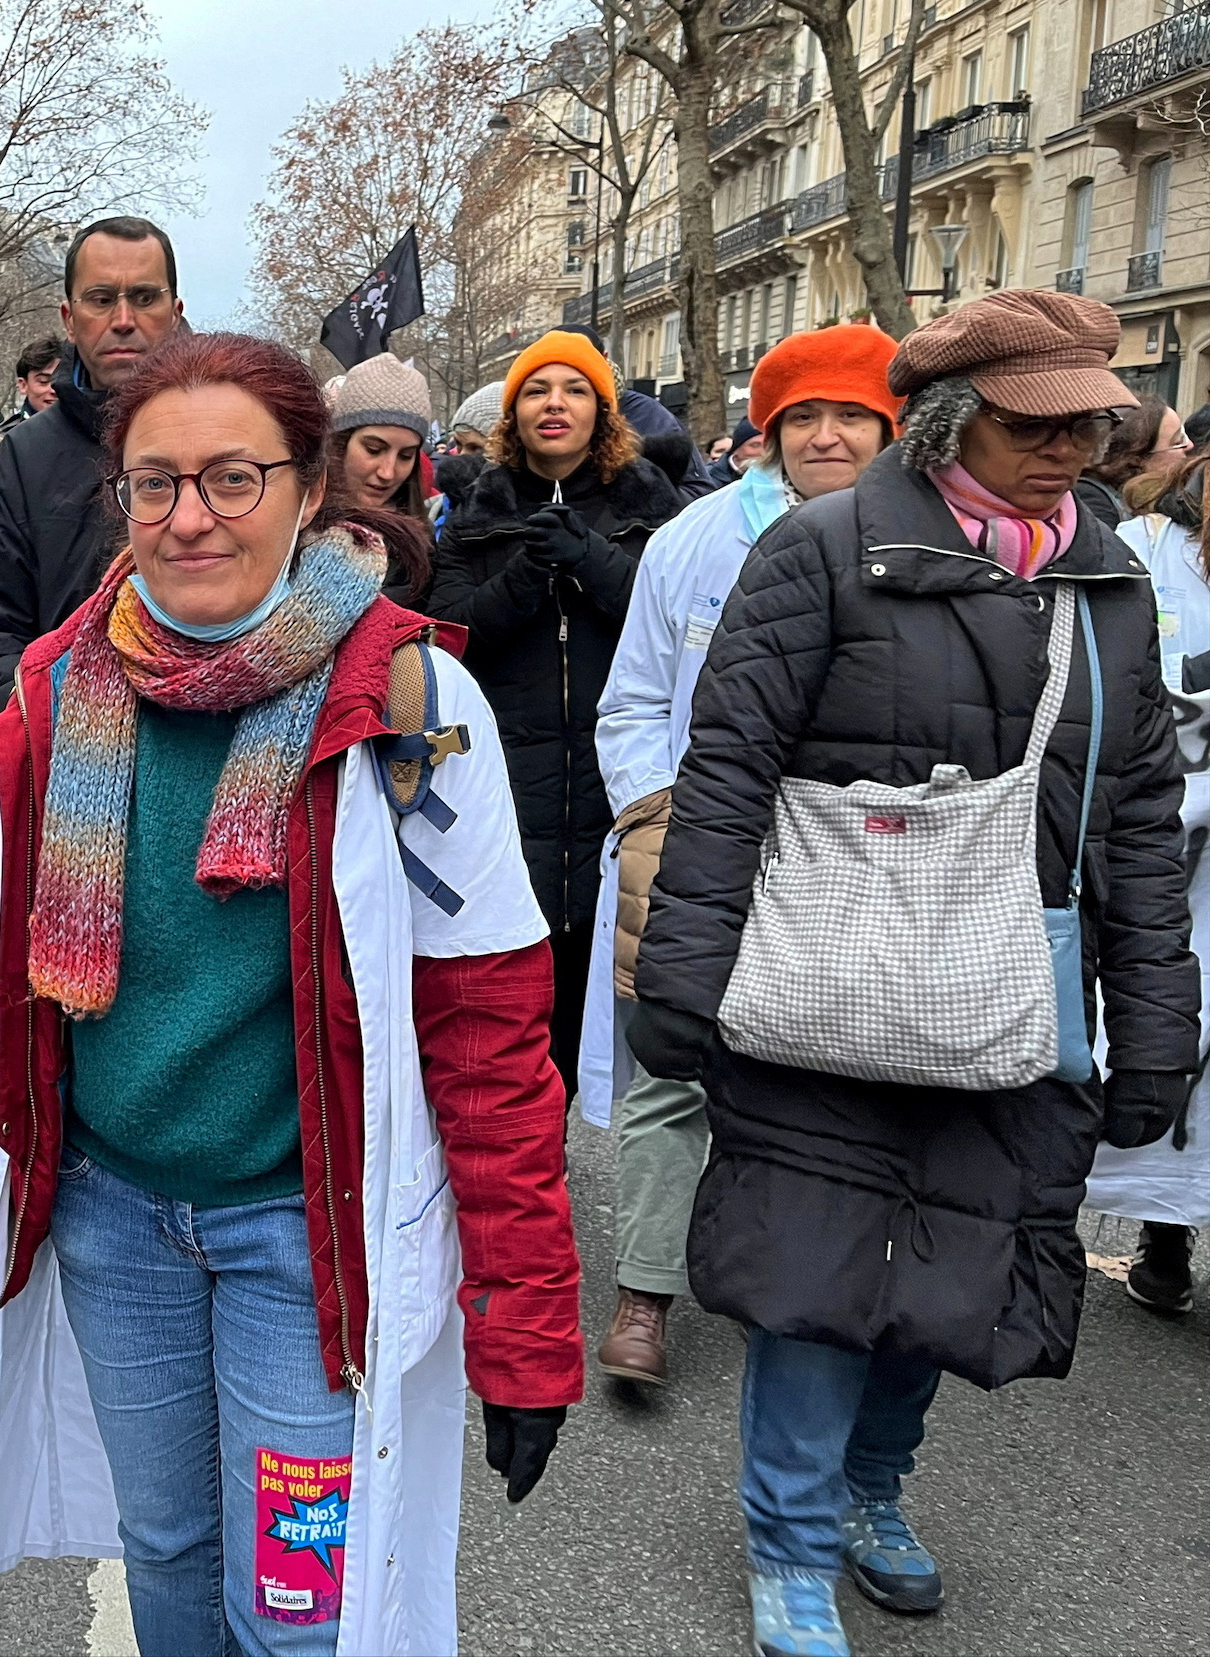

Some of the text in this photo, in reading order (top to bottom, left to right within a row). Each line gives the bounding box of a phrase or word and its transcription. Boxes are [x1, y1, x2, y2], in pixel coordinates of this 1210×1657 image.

[261, 1452, 279, 1474] Ne
[282, 1462, 316, 1480] nous
[261, 1475, 324, 1498] pas voler
[306, 1503, 339, 1523] NOS
[270, 1592, 308, 1605] Solidaires
